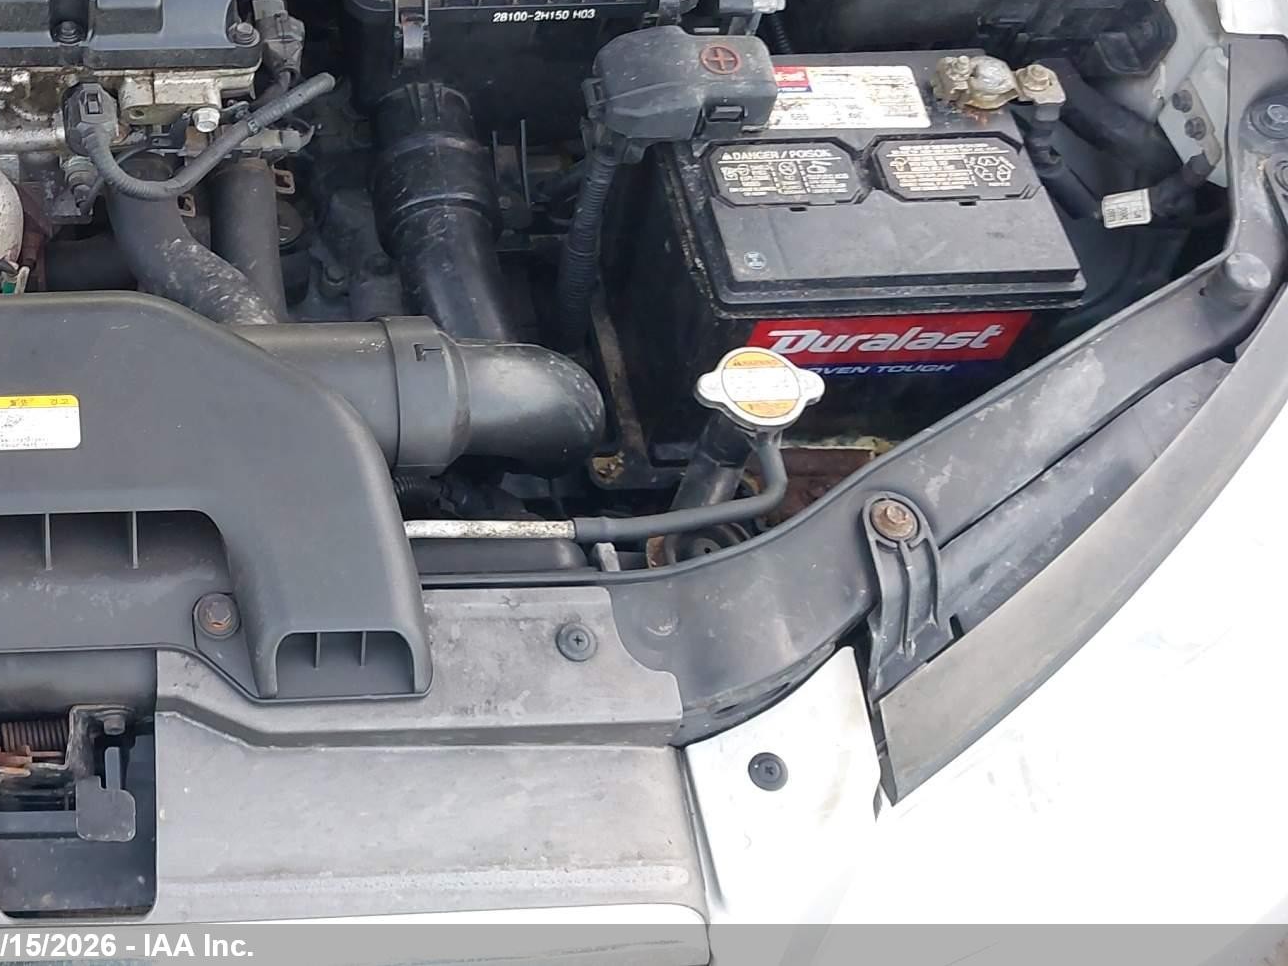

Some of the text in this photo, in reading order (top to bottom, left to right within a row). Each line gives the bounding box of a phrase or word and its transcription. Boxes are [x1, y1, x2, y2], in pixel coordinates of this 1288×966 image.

[493, 8, 596, 23] 28100-2H150 H03
[731, 151, 779, 160] DANGER
[789, 149, 832, 159] POISON
[768, 323, 1006, 355] Duralast
[877, 363, 956, 375] TOUGH
